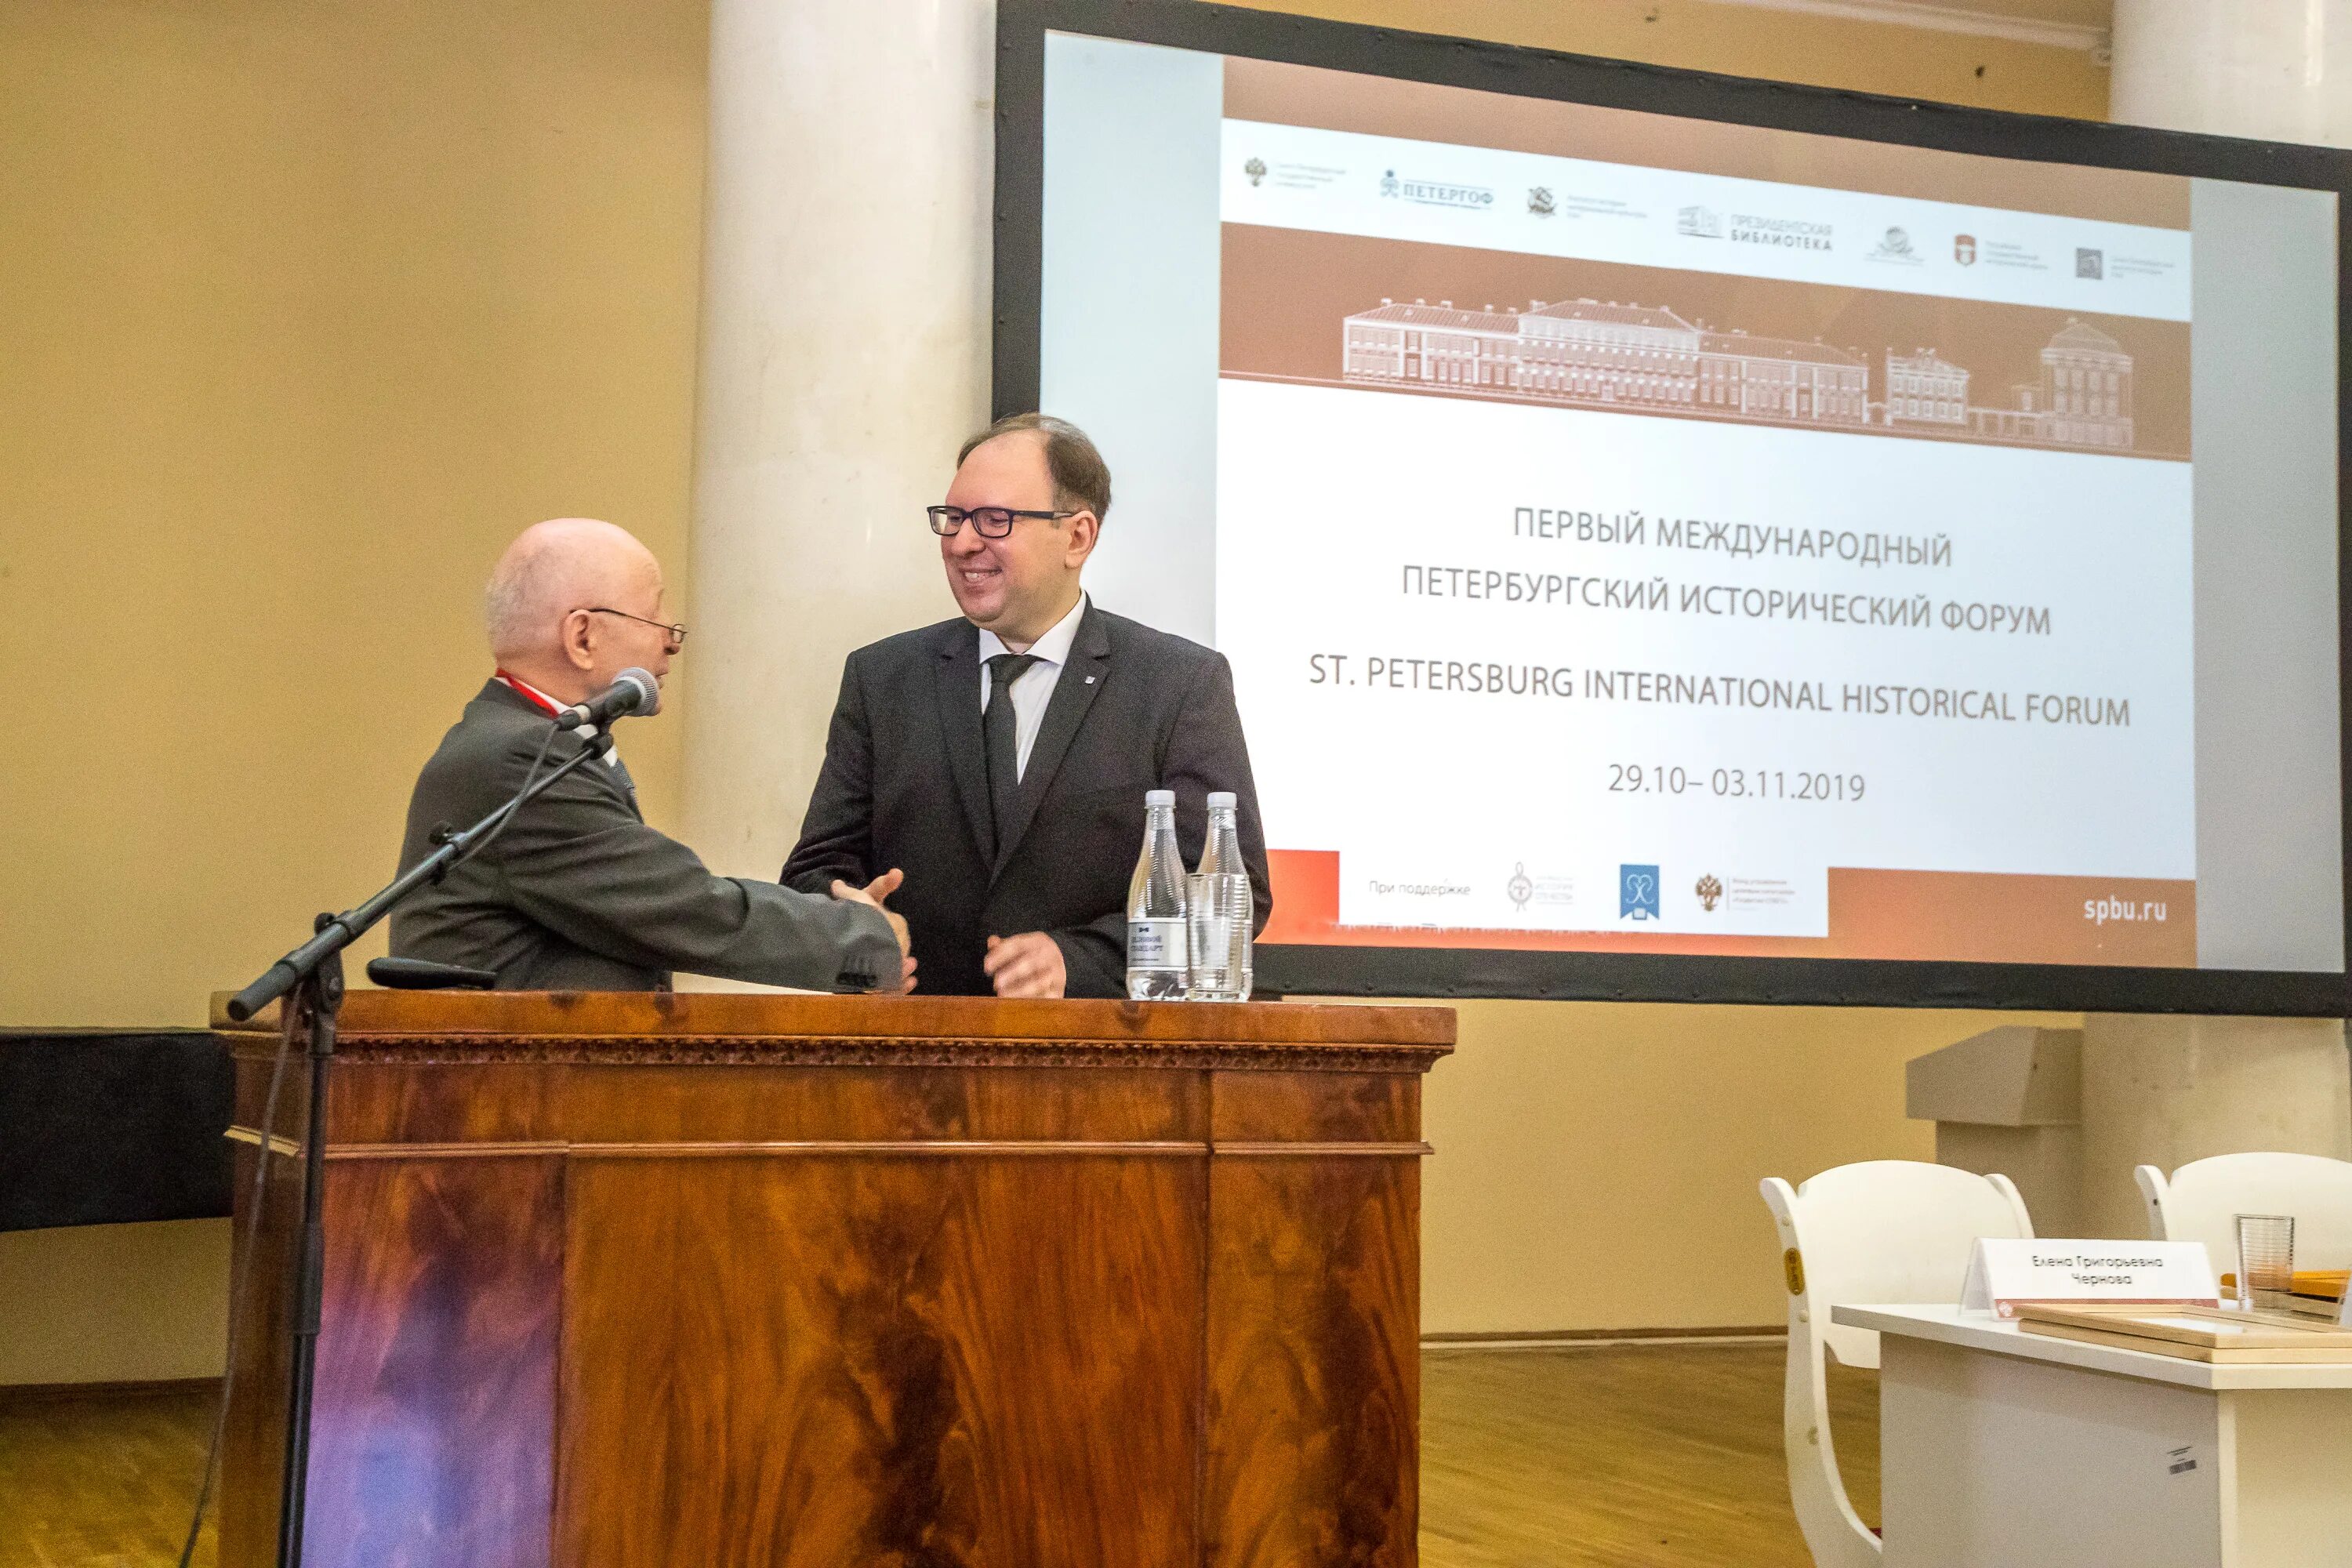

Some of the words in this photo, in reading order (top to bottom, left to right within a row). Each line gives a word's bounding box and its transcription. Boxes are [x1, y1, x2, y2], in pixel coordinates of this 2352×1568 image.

[1403, 183, 1494, 205] ПЕТЕРГОФ
[1730, 229, 1833, 251] БИБЛИОТЕКА
[1514, 506, 1645, 545] ПЕРВЫЙ
[1657, 517, 1952, 568] МЕЖДУНАРОДНЫЙ
[1402, 564, 1668, 612] ПЕТЕРБУРГСКИЙ
[1680, 584, 1931, 629] ИСТОРИЧЕСКИЙ
[1940, 599, 2052, 635] ФОРУМ
[1308, 654, 1356, 686] ST.
[1367, 657, 1573, 698] PETERSBURG
[1584, 670, 1833, 712] INTERNATIONAL
[1842, 684, 2016, 721] HISTORICAL
[2025, 693, 2131, 728] FORUM
[1711, 768, 1866, 802] 03.11.2019
[1369, 880, 1395, 895] При
[1399, 884, 1471, 897] поддержке
[2084, 892, 2167, 925] spbu.ru
[2032, 1255, 2073, 1267] Елена
[2076, 1255, 2164, 1269] Григорьевна
[2071, 1272, 2132, 1287] Чернова
